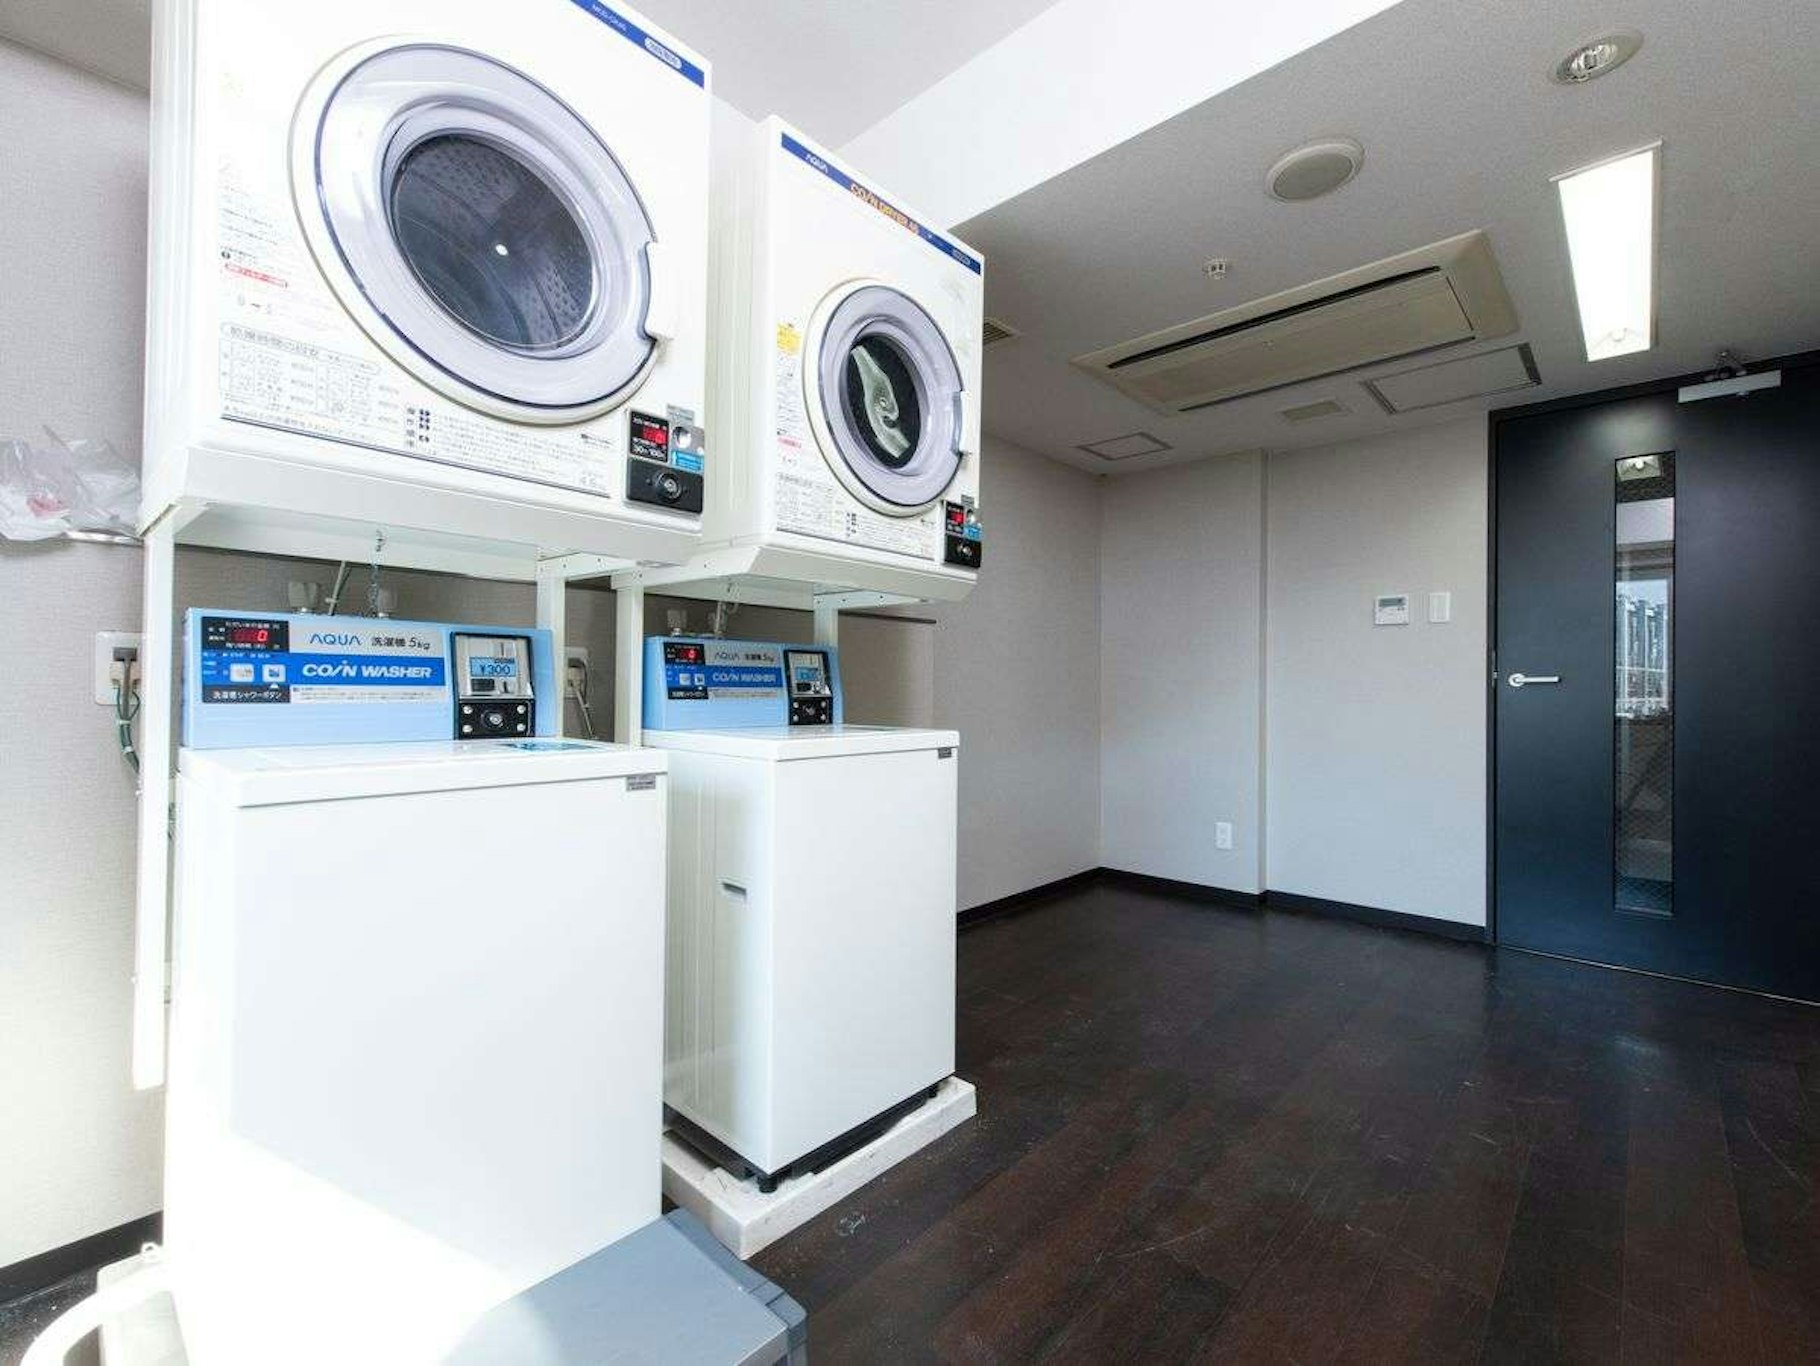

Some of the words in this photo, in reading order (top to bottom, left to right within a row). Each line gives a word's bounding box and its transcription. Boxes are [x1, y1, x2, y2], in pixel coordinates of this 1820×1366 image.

[310, 633, 362, 647] AQUA
[371, 635, 406, 648] 洗濯機
[408, 636, 431, 651] 5kg
[362, 665, 433, 679] WASHER
